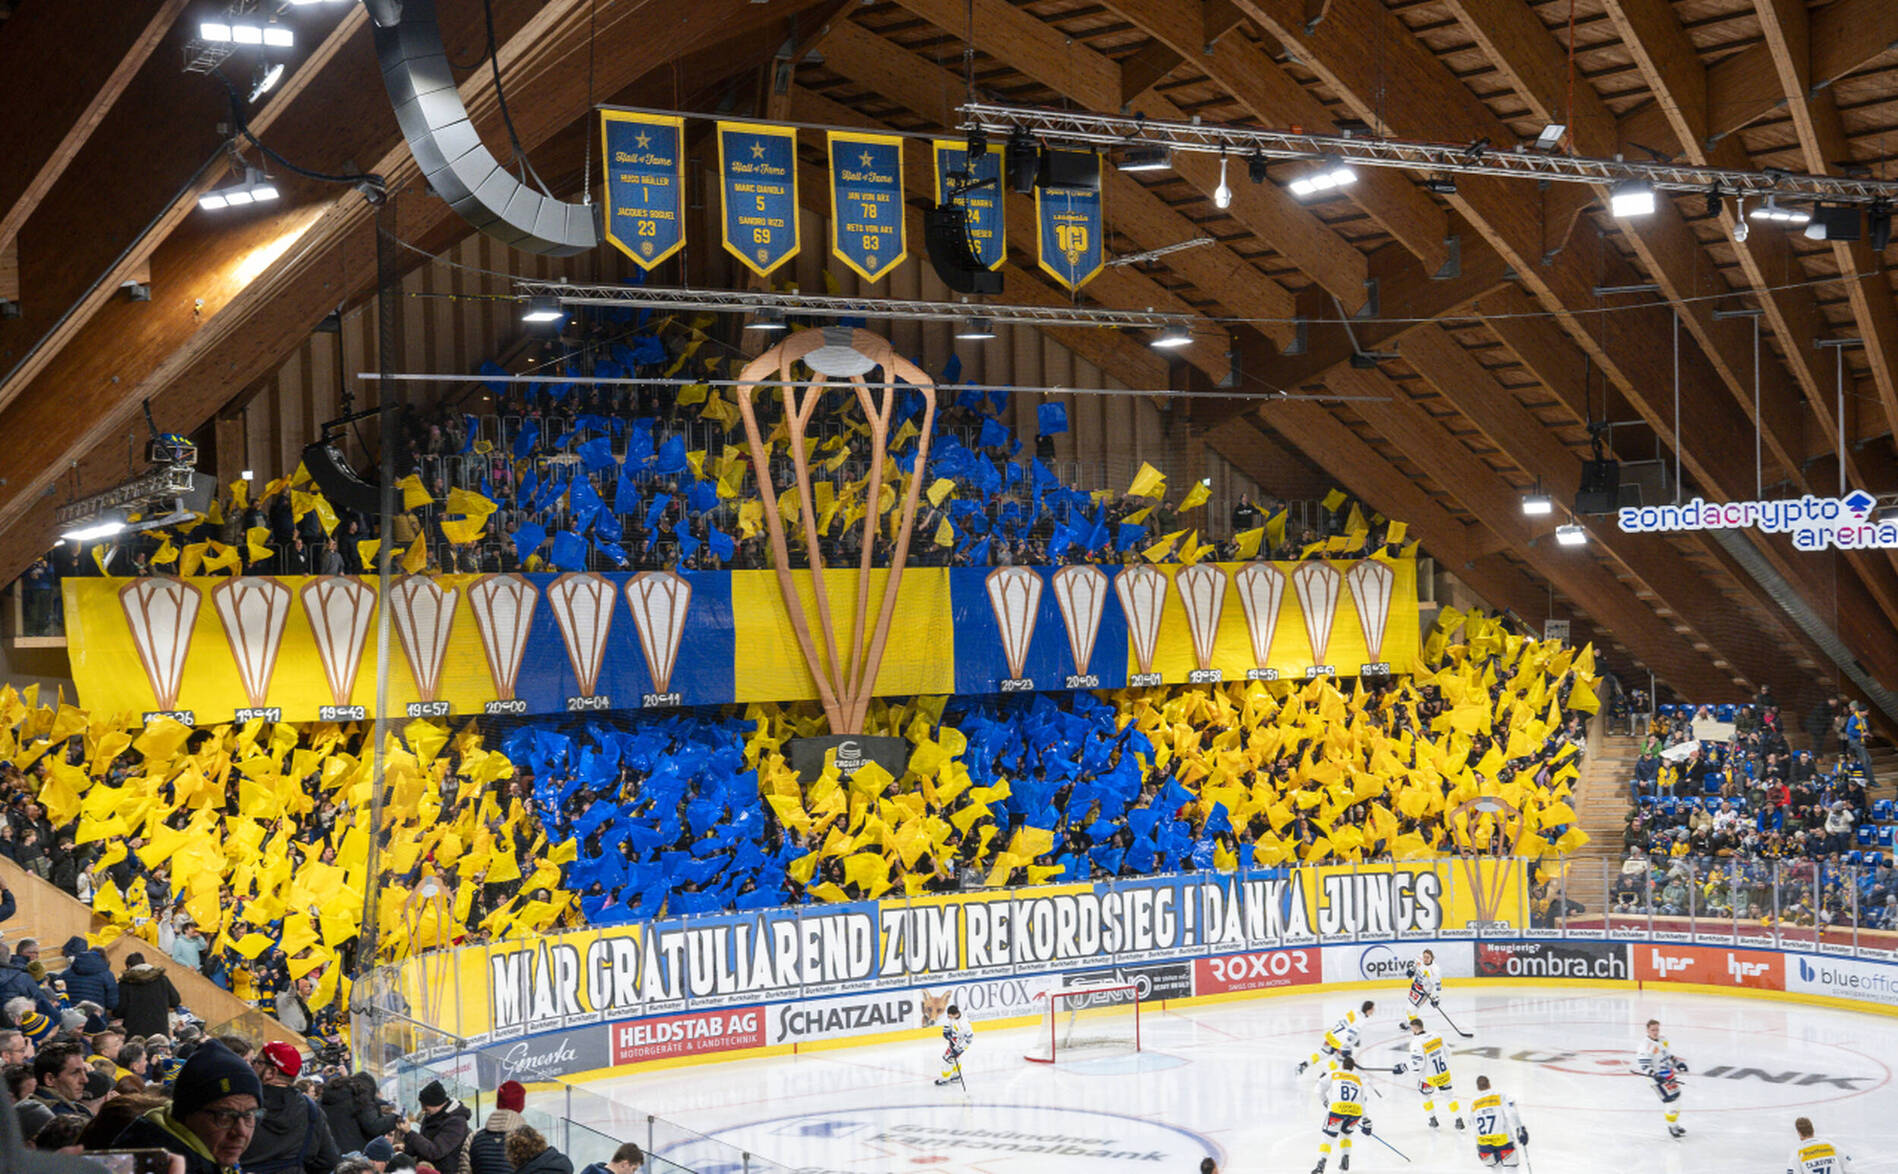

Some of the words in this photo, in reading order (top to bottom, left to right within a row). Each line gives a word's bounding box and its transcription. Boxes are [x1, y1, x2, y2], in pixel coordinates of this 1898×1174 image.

[643, 186, 648, 203] 1
[756, 195, 765, 211] 5
[860, 203, 877, 219] 78
[638, 220, 656, 236] 23
[753, 228, 771, 244] 69
[862, 235, 879, 251] 83
[1622, 499, 1840, 529] zondacrypto
[1797, 524, 1898, 547] arena
[491, 938, 581, 1030] MIAR
[586, 910, 874, 1011] GRATULIAREND
[880, 903, 960, 978] ZUM
[1202, 870, 1318, 945] DANKA
[1318, 871, 1442, 935] JUNGS
[1209, 950, 1310, 982] ROXOR
[1506, 951, 1625, 978] ombra.ch
[954, 979, 1030, 1011] COFOX
[620, 1017, 723, 1048] HELDSTAB
[727, 1013, 757, 1035] AG
[777, 1000, 913, 1042] SCHATZALP
[620, 1043, 682, 1059] MOTORGERÄTE
[697, 1034, 757, 1049] LANDTECHNIK
[1432, 1055, 1447, 1075] 16
[1341, 1085, 1358, 1102] 87
[1476, 1115, 1496, 1135] 27
